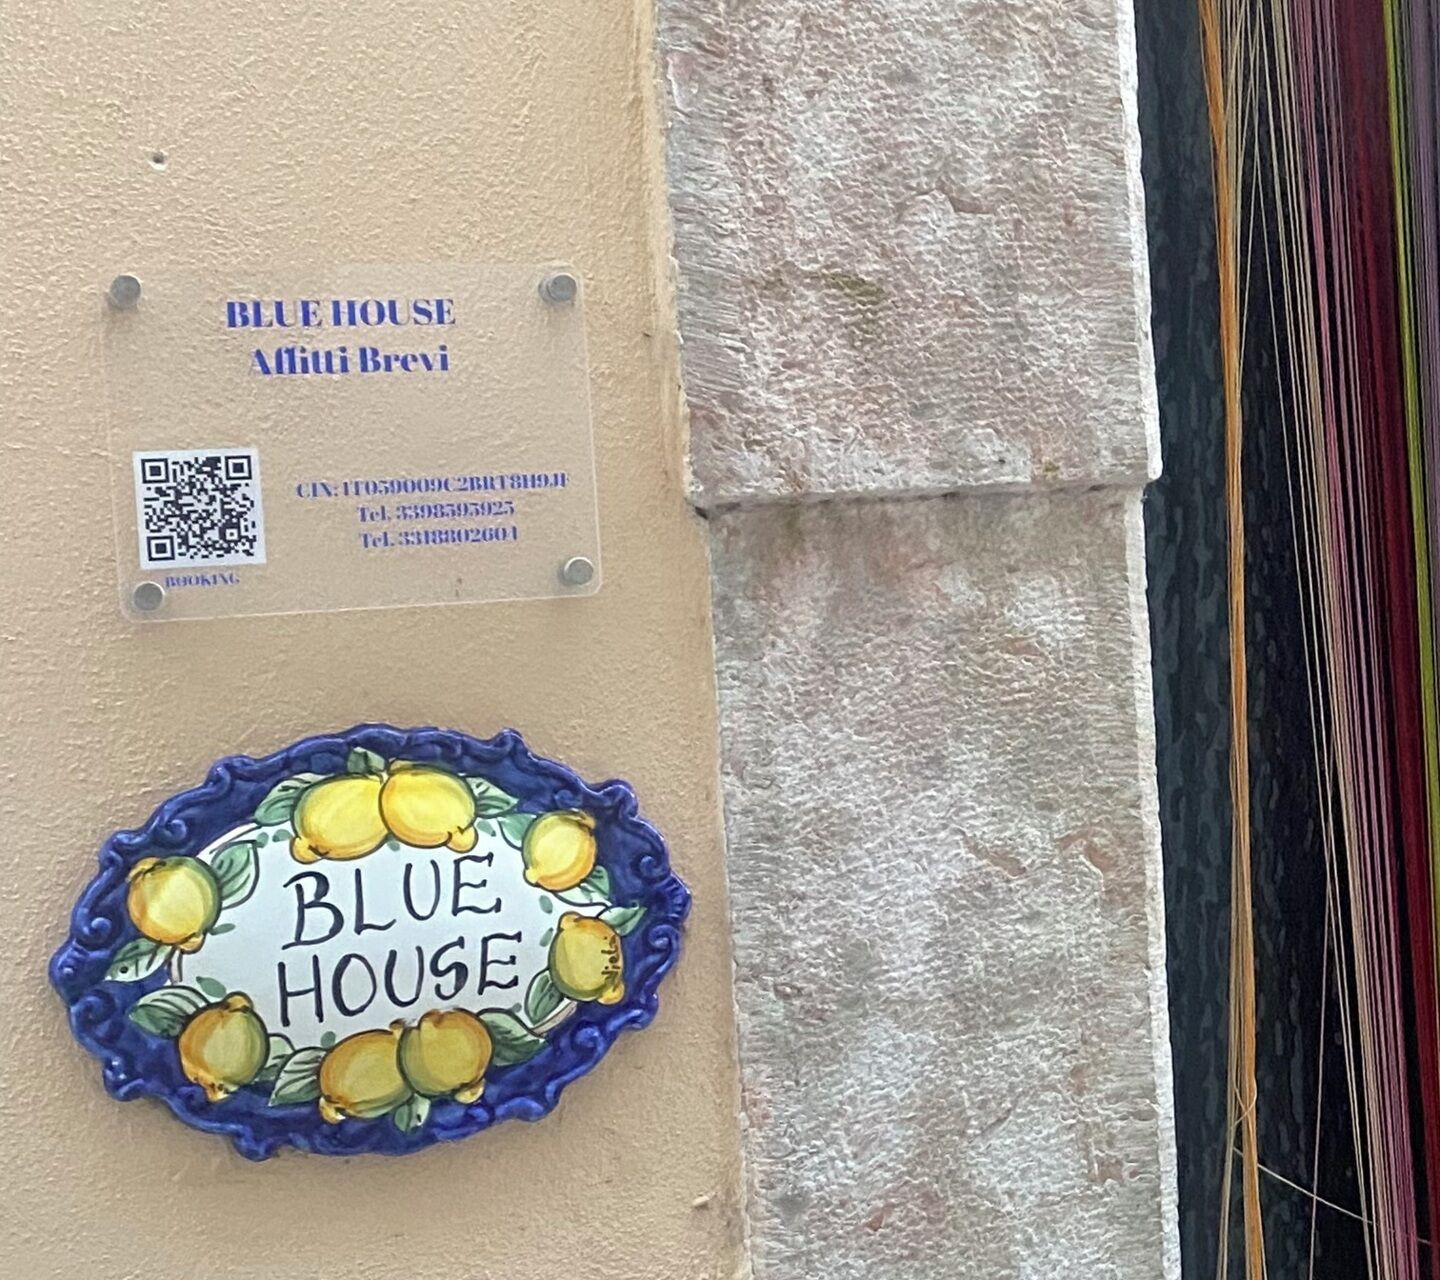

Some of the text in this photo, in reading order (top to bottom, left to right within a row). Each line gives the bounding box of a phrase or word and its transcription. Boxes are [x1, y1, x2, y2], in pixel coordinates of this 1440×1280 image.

[226, 298, 456, 328] BLUE HOUSE
[252, 344, 449, 375] Affitti Brevi
[357, 505, 391, 522] Tel.
[360, 531, 395, 548] Tel.
[165, 572, 240, 588] BOOKING
[282, 851, 502, 951] BLUE
[277, 932, 524, 1028] HOUSE
